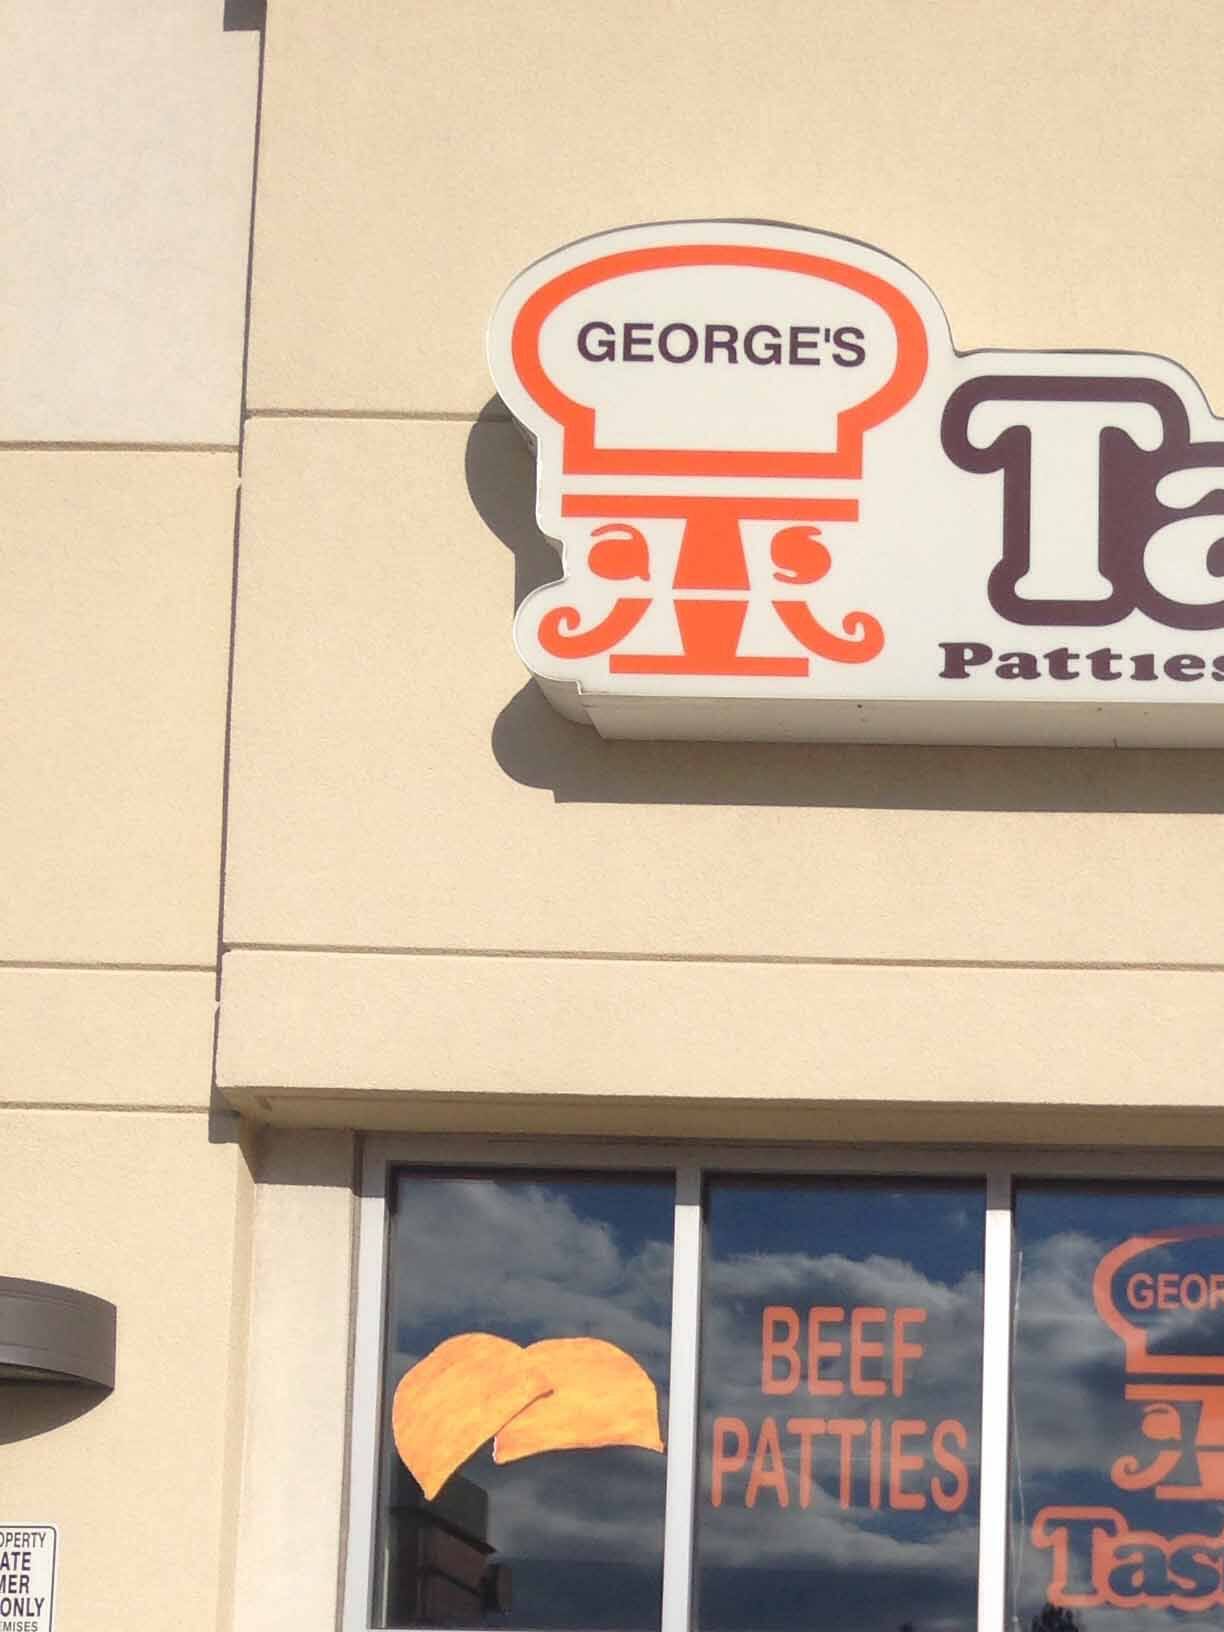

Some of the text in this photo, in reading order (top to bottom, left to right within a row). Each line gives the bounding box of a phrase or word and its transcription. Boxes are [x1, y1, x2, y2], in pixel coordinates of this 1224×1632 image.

[577, 321, 867, 370] GEORGE'S
[761, 1306, 928, 1397] BEEF
[711, 1417, 969, 1512] PATTIES
[0, 1597, 45, 1617] ONLY
[0, 1621, 38, 1632] MISES
